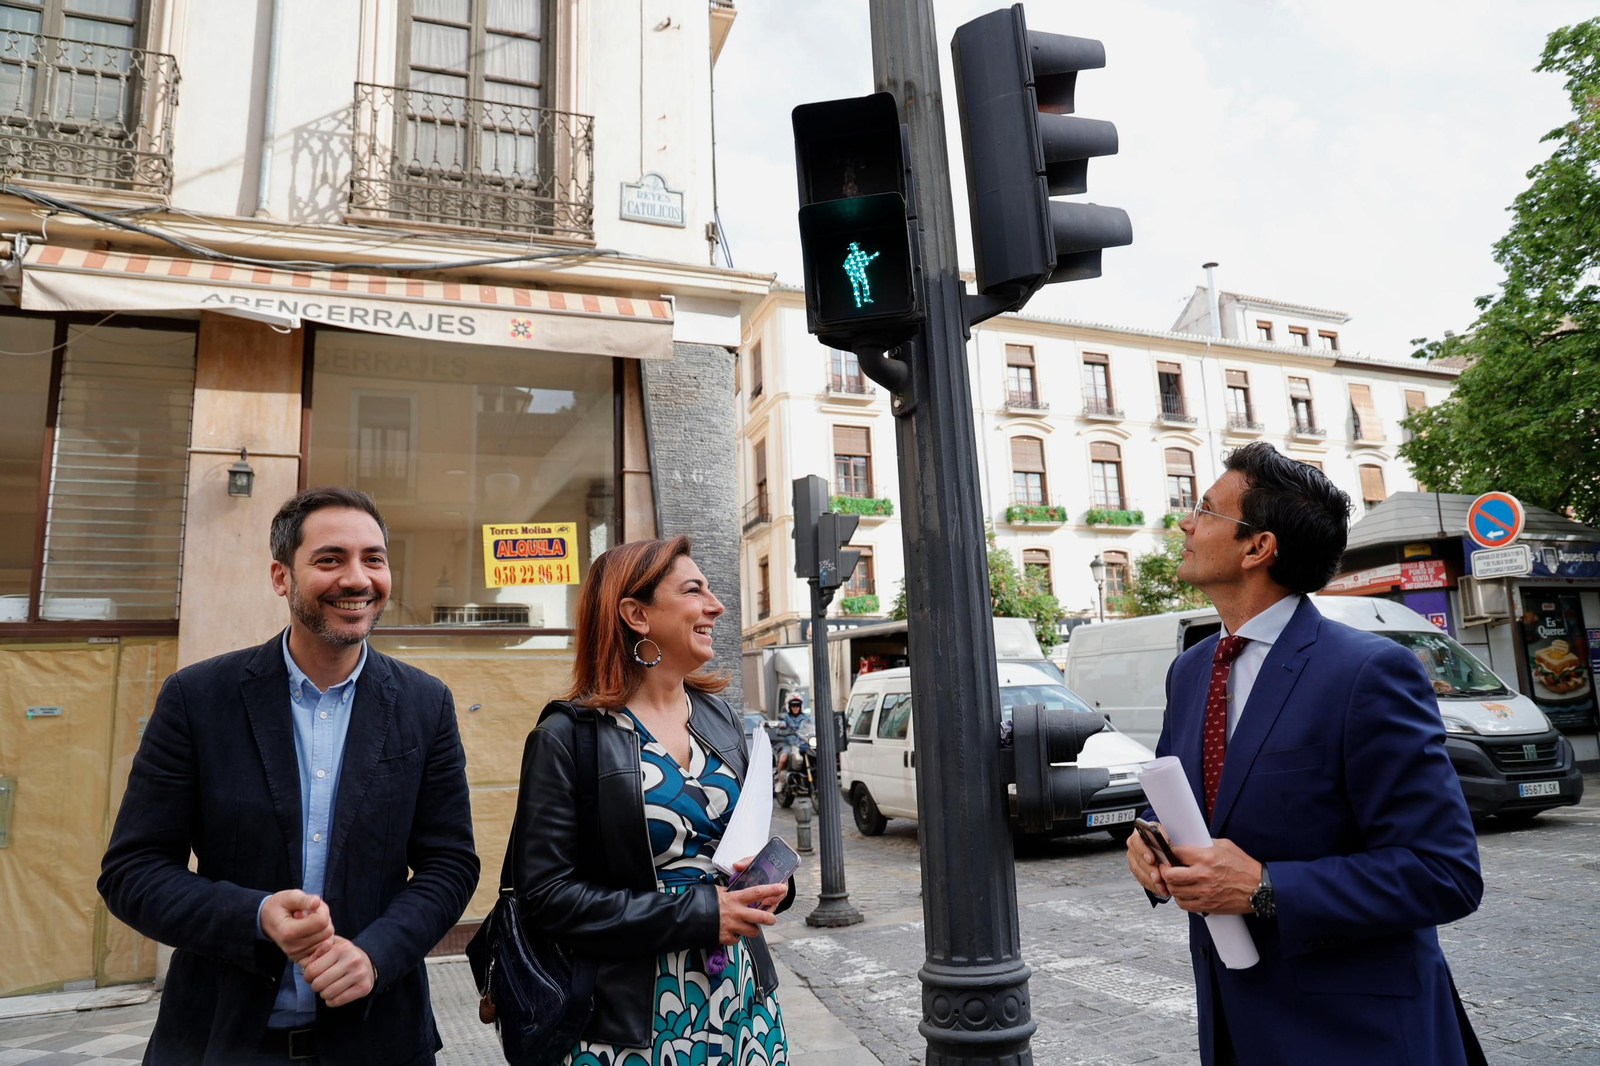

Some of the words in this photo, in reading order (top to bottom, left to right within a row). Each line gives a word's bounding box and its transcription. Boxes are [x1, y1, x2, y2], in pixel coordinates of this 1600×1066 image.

[636, 190, 671, 203] REYES
[627, 200, 681, 220] CATOLICOS
[489, 527, 519, 535] Torres
[521, 526, 552, 535] Molina
[497, 539, 564, 557] ALQUILA
[1558, 550, 1595, 563] Apuestas
[494, 565, 517, 586] 958
[520, 565, 534, 584] 22
[557, 564, 571, 582] 34
[1408, 568, 1428, 576] PUNTO
[1430, 573, 1434, 581] E
[1405, 580, 1443, 589] INFORMACIÓN
[1545, 617, 1556, 627] Es
[1524, 784, 1542, 795] 9567
[1544, 783, 1558, 793] LSK
[1093, 814, 1115, 825] 8231
[1118, 811, 1133, 822] BYG
[768, 853, 784, 869] 9:47
